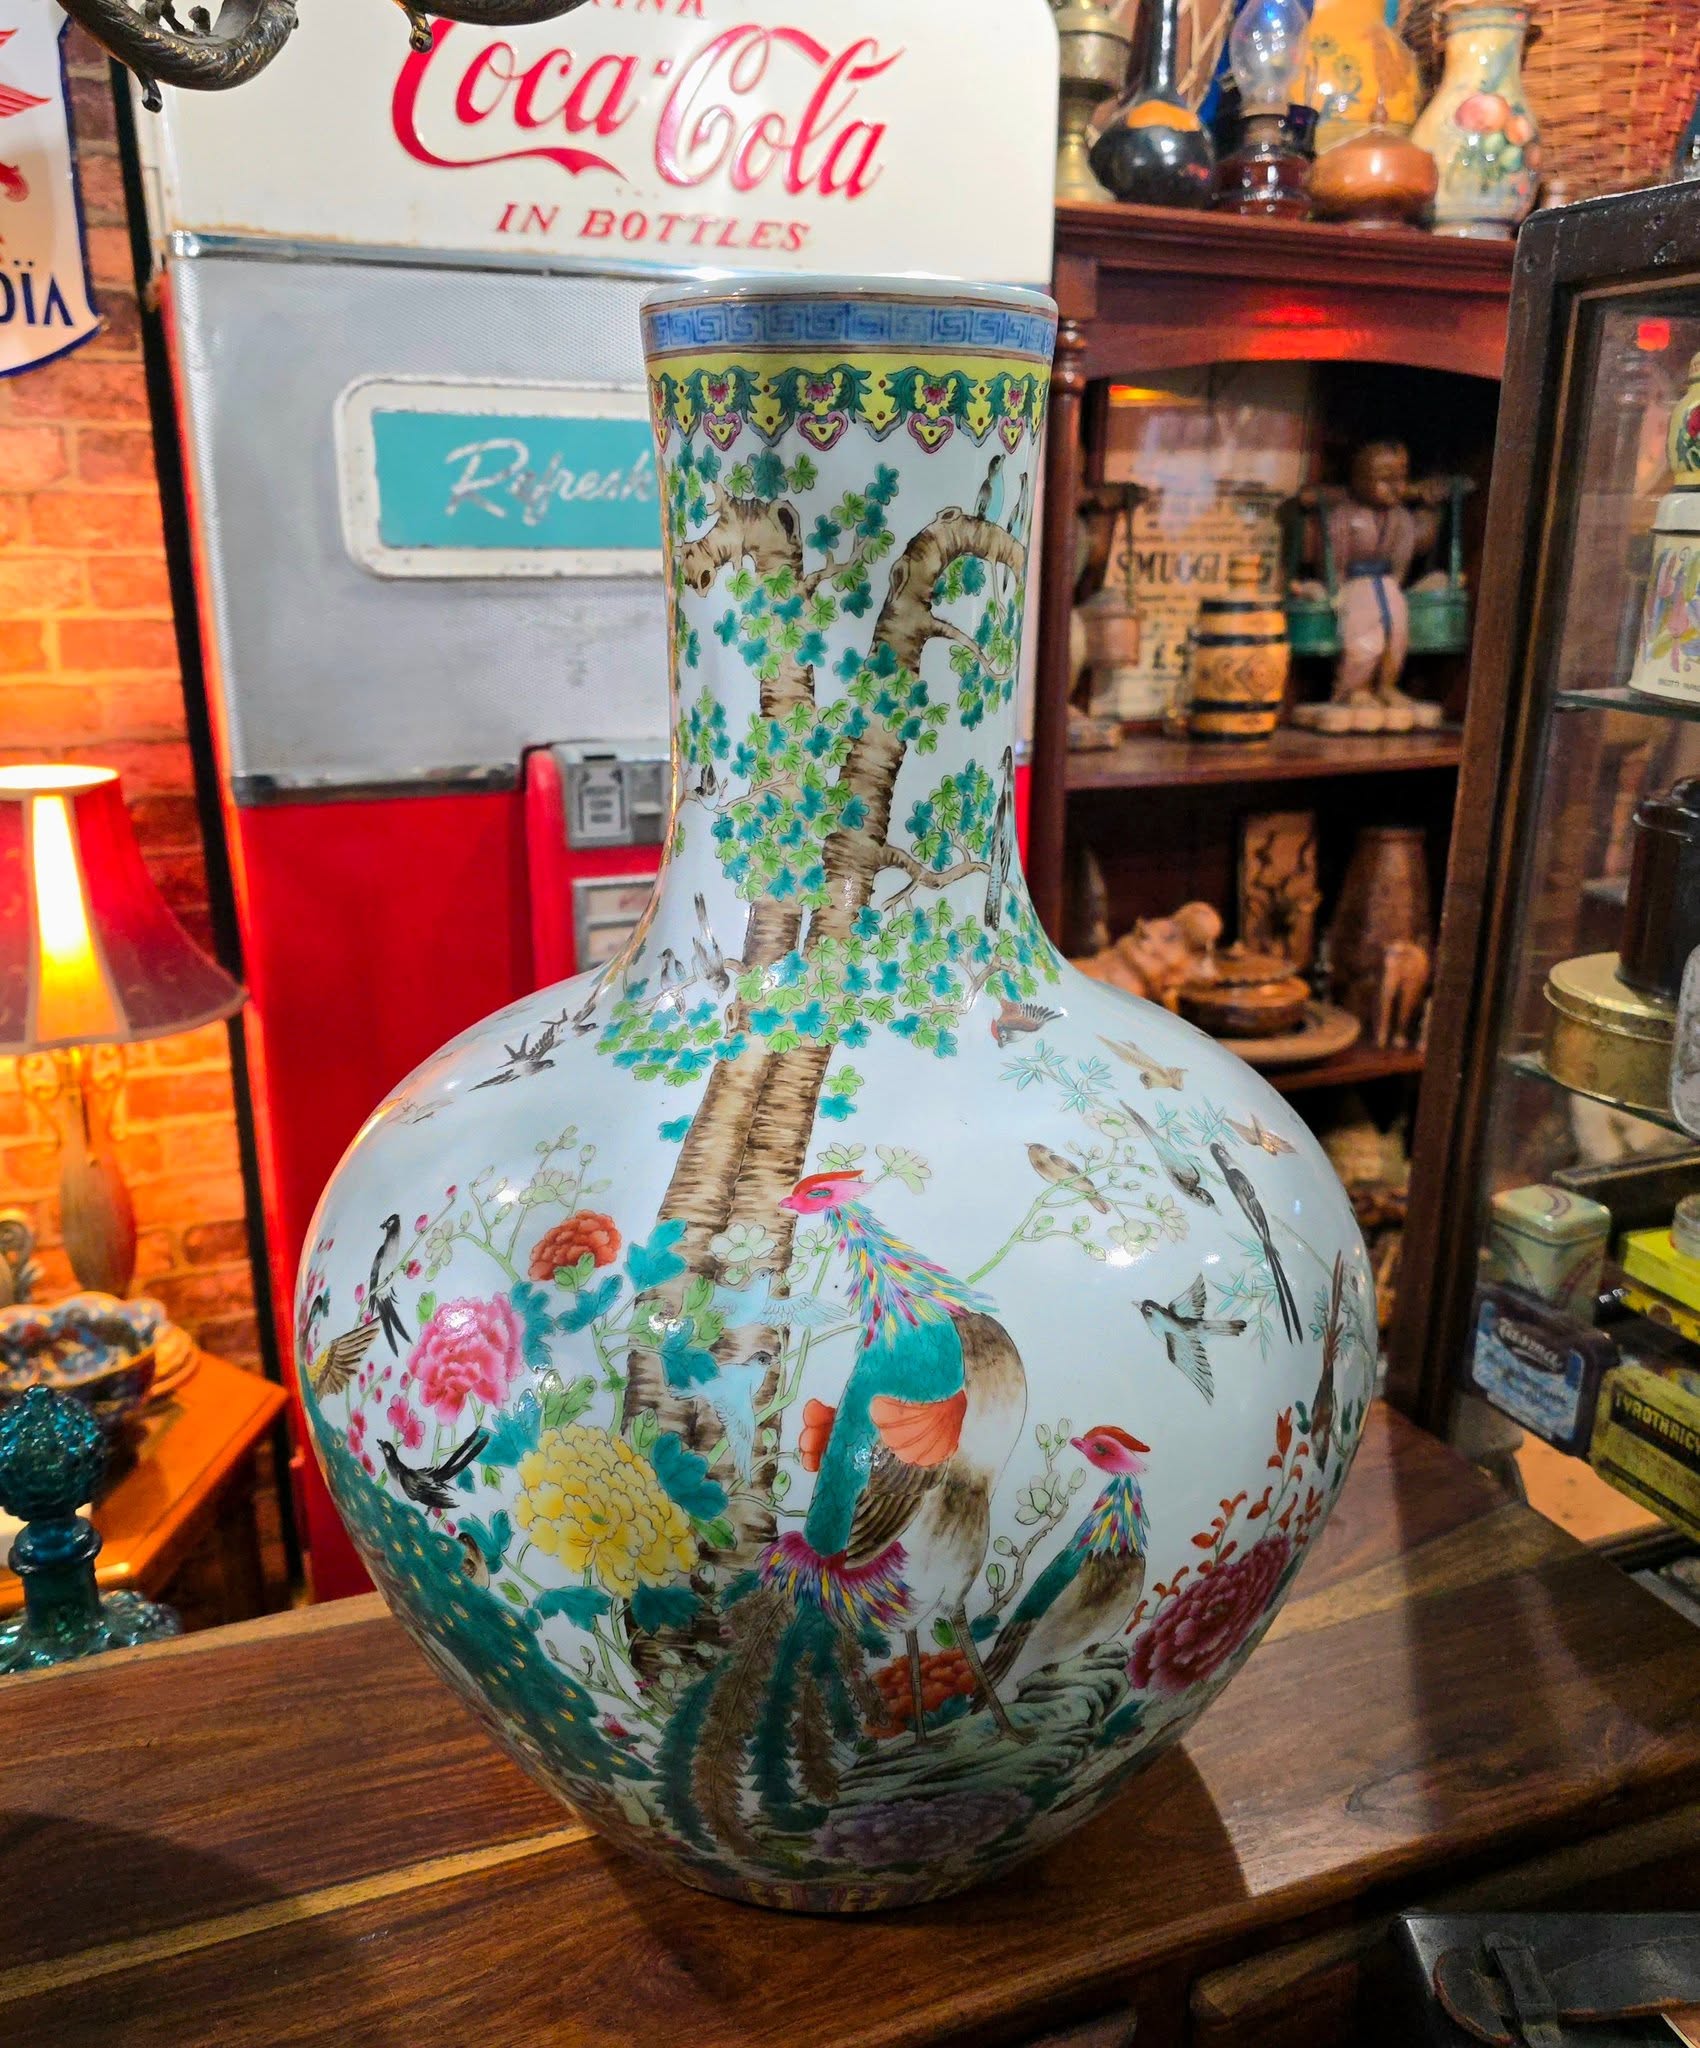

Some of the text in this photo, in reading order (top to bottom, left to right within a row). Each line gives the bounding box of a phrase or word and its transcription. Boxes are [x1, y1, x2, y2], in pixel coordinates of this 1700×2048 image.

[391, 18, 907, 199] Coca-Cola
[496, 203, 811, 252] IN BOTTLES
